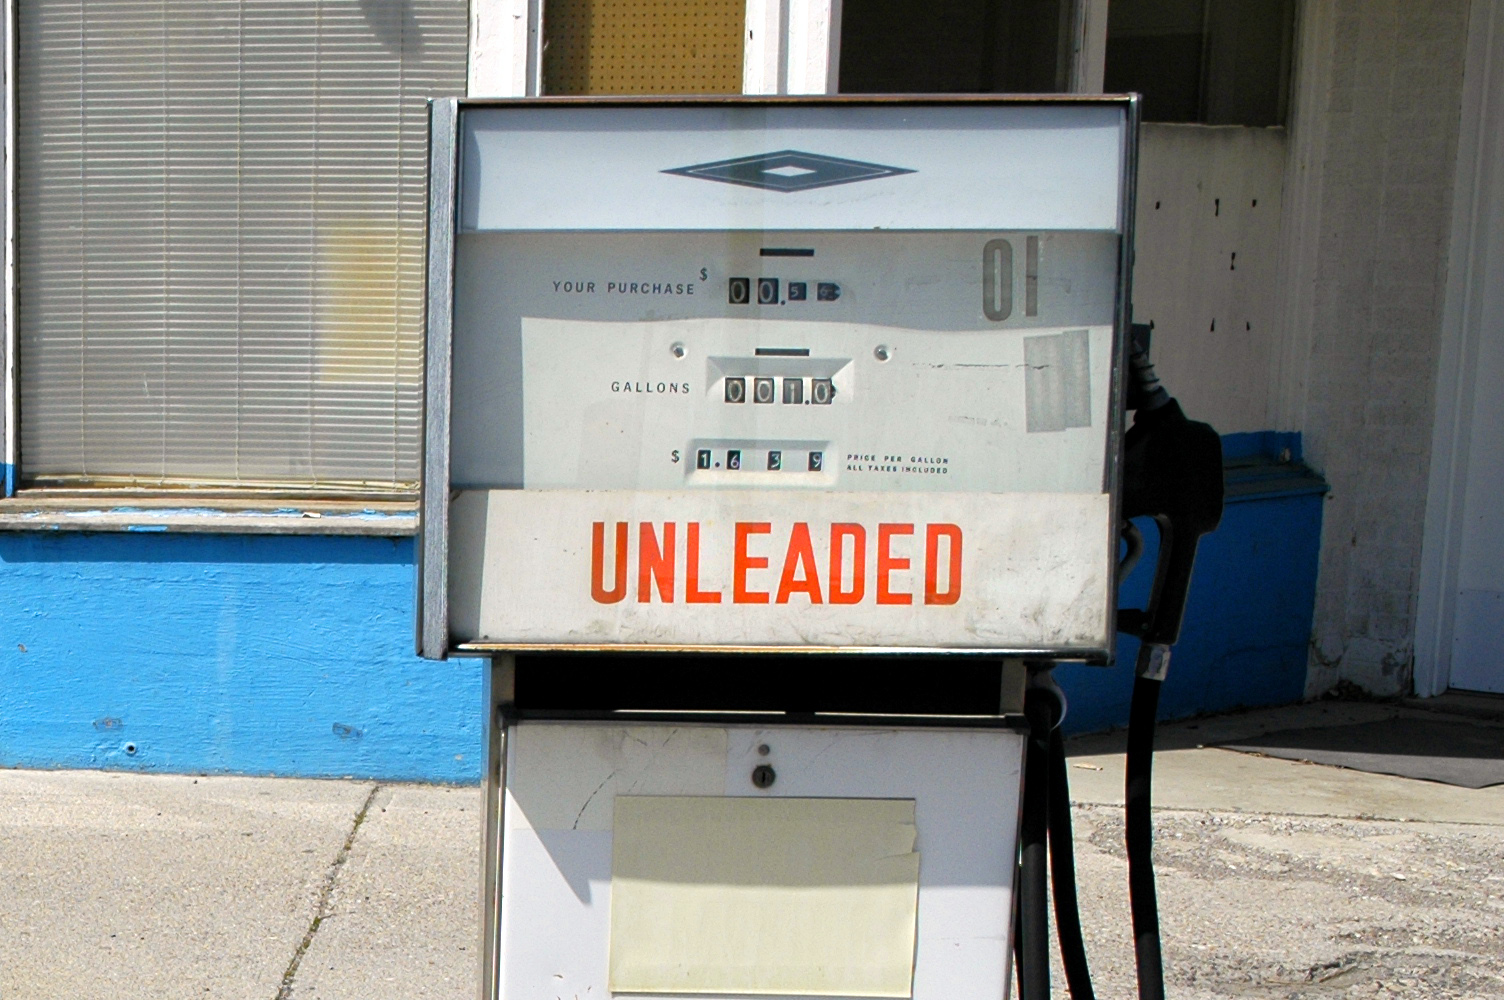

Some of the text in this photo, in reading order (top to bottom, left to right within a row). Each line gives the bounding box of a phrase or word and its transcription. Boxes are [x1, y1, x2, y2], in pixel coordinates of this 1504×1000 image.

[552, 281, 695, 295] YOUR PURCHASE
[611, 381, 690, 394] GALLONS
[910, 456, 948, 464] GALLON
[901, 466, 948, 474] INCLUDED
[591, 521, 963, 605] UNLEADED
